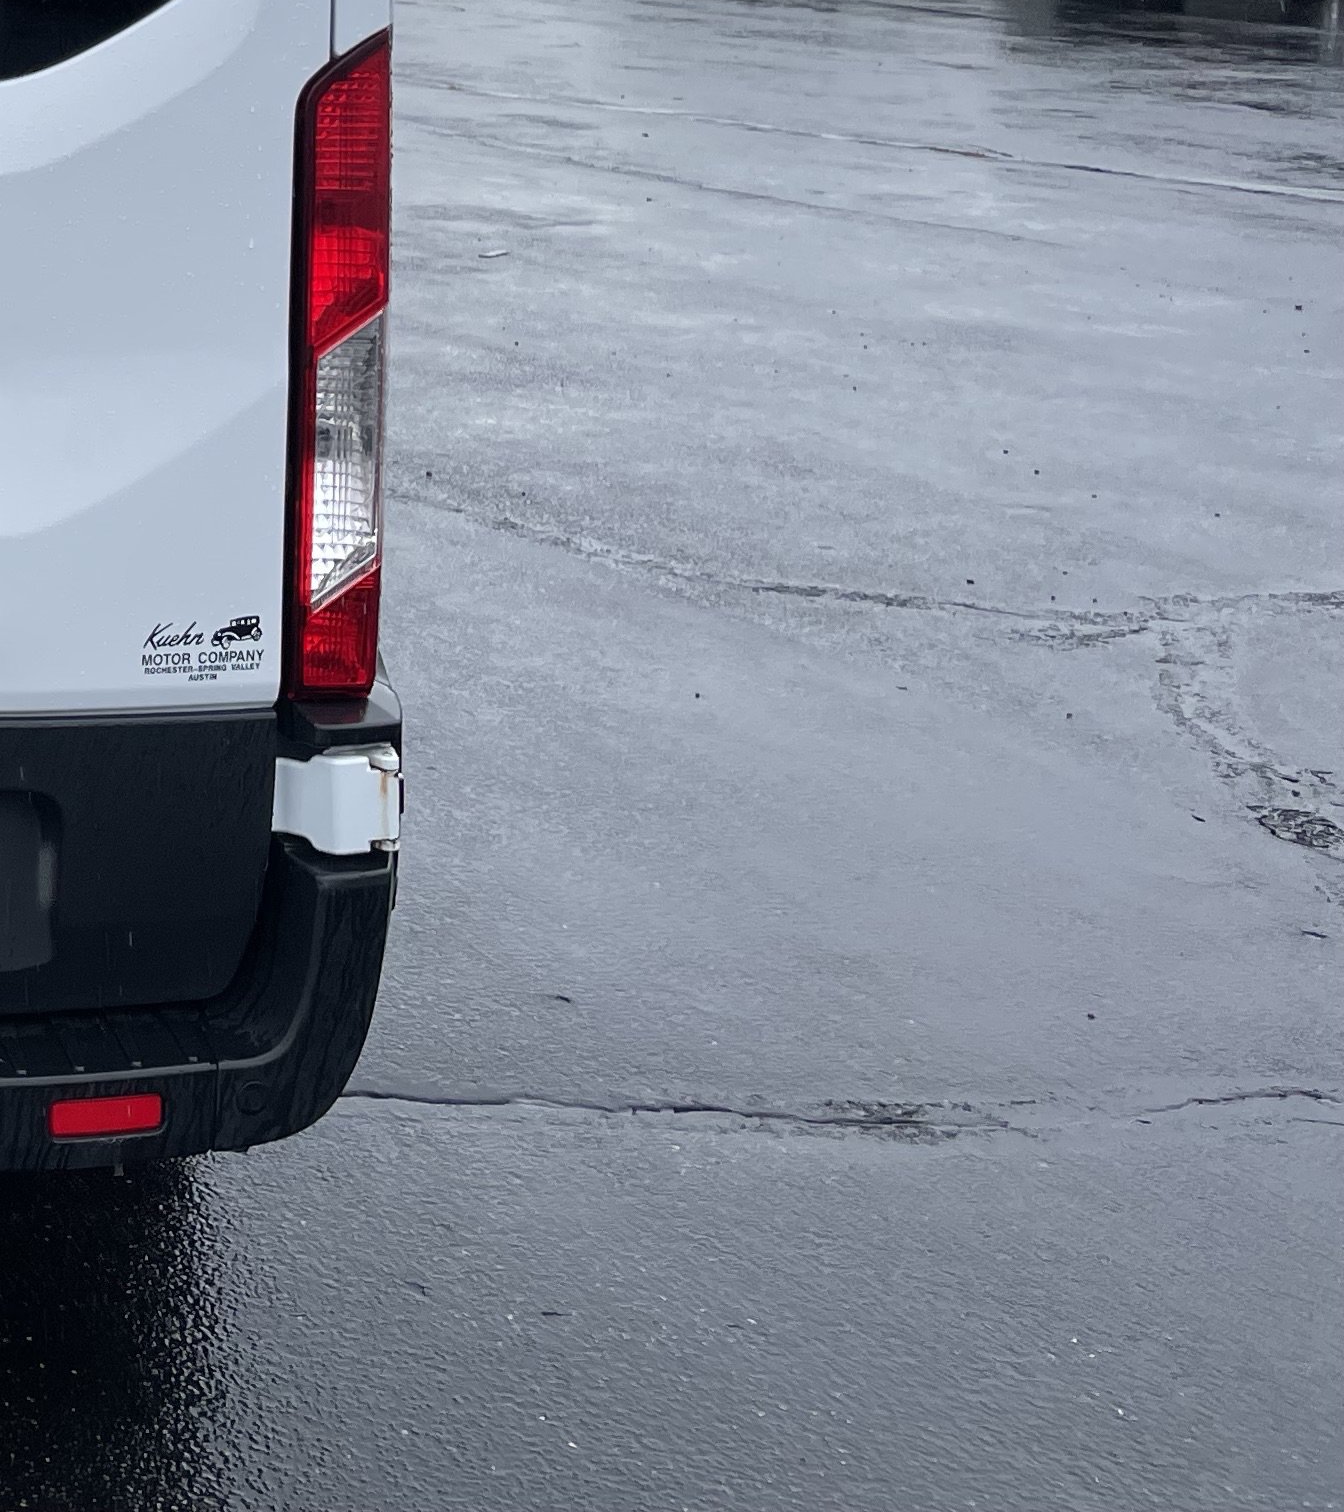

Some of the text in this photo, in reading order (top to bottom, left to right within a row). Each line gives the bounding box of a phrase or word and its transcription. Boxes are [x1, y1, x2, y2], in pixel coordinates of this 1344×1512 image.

[143, 621, 205, 650] Kuehn
[141, 649, 265, 666] MOTOR COMPANY
[230, 662, 261, 671] VALLEY
[188, 673, 218, 682] AUSTIN
